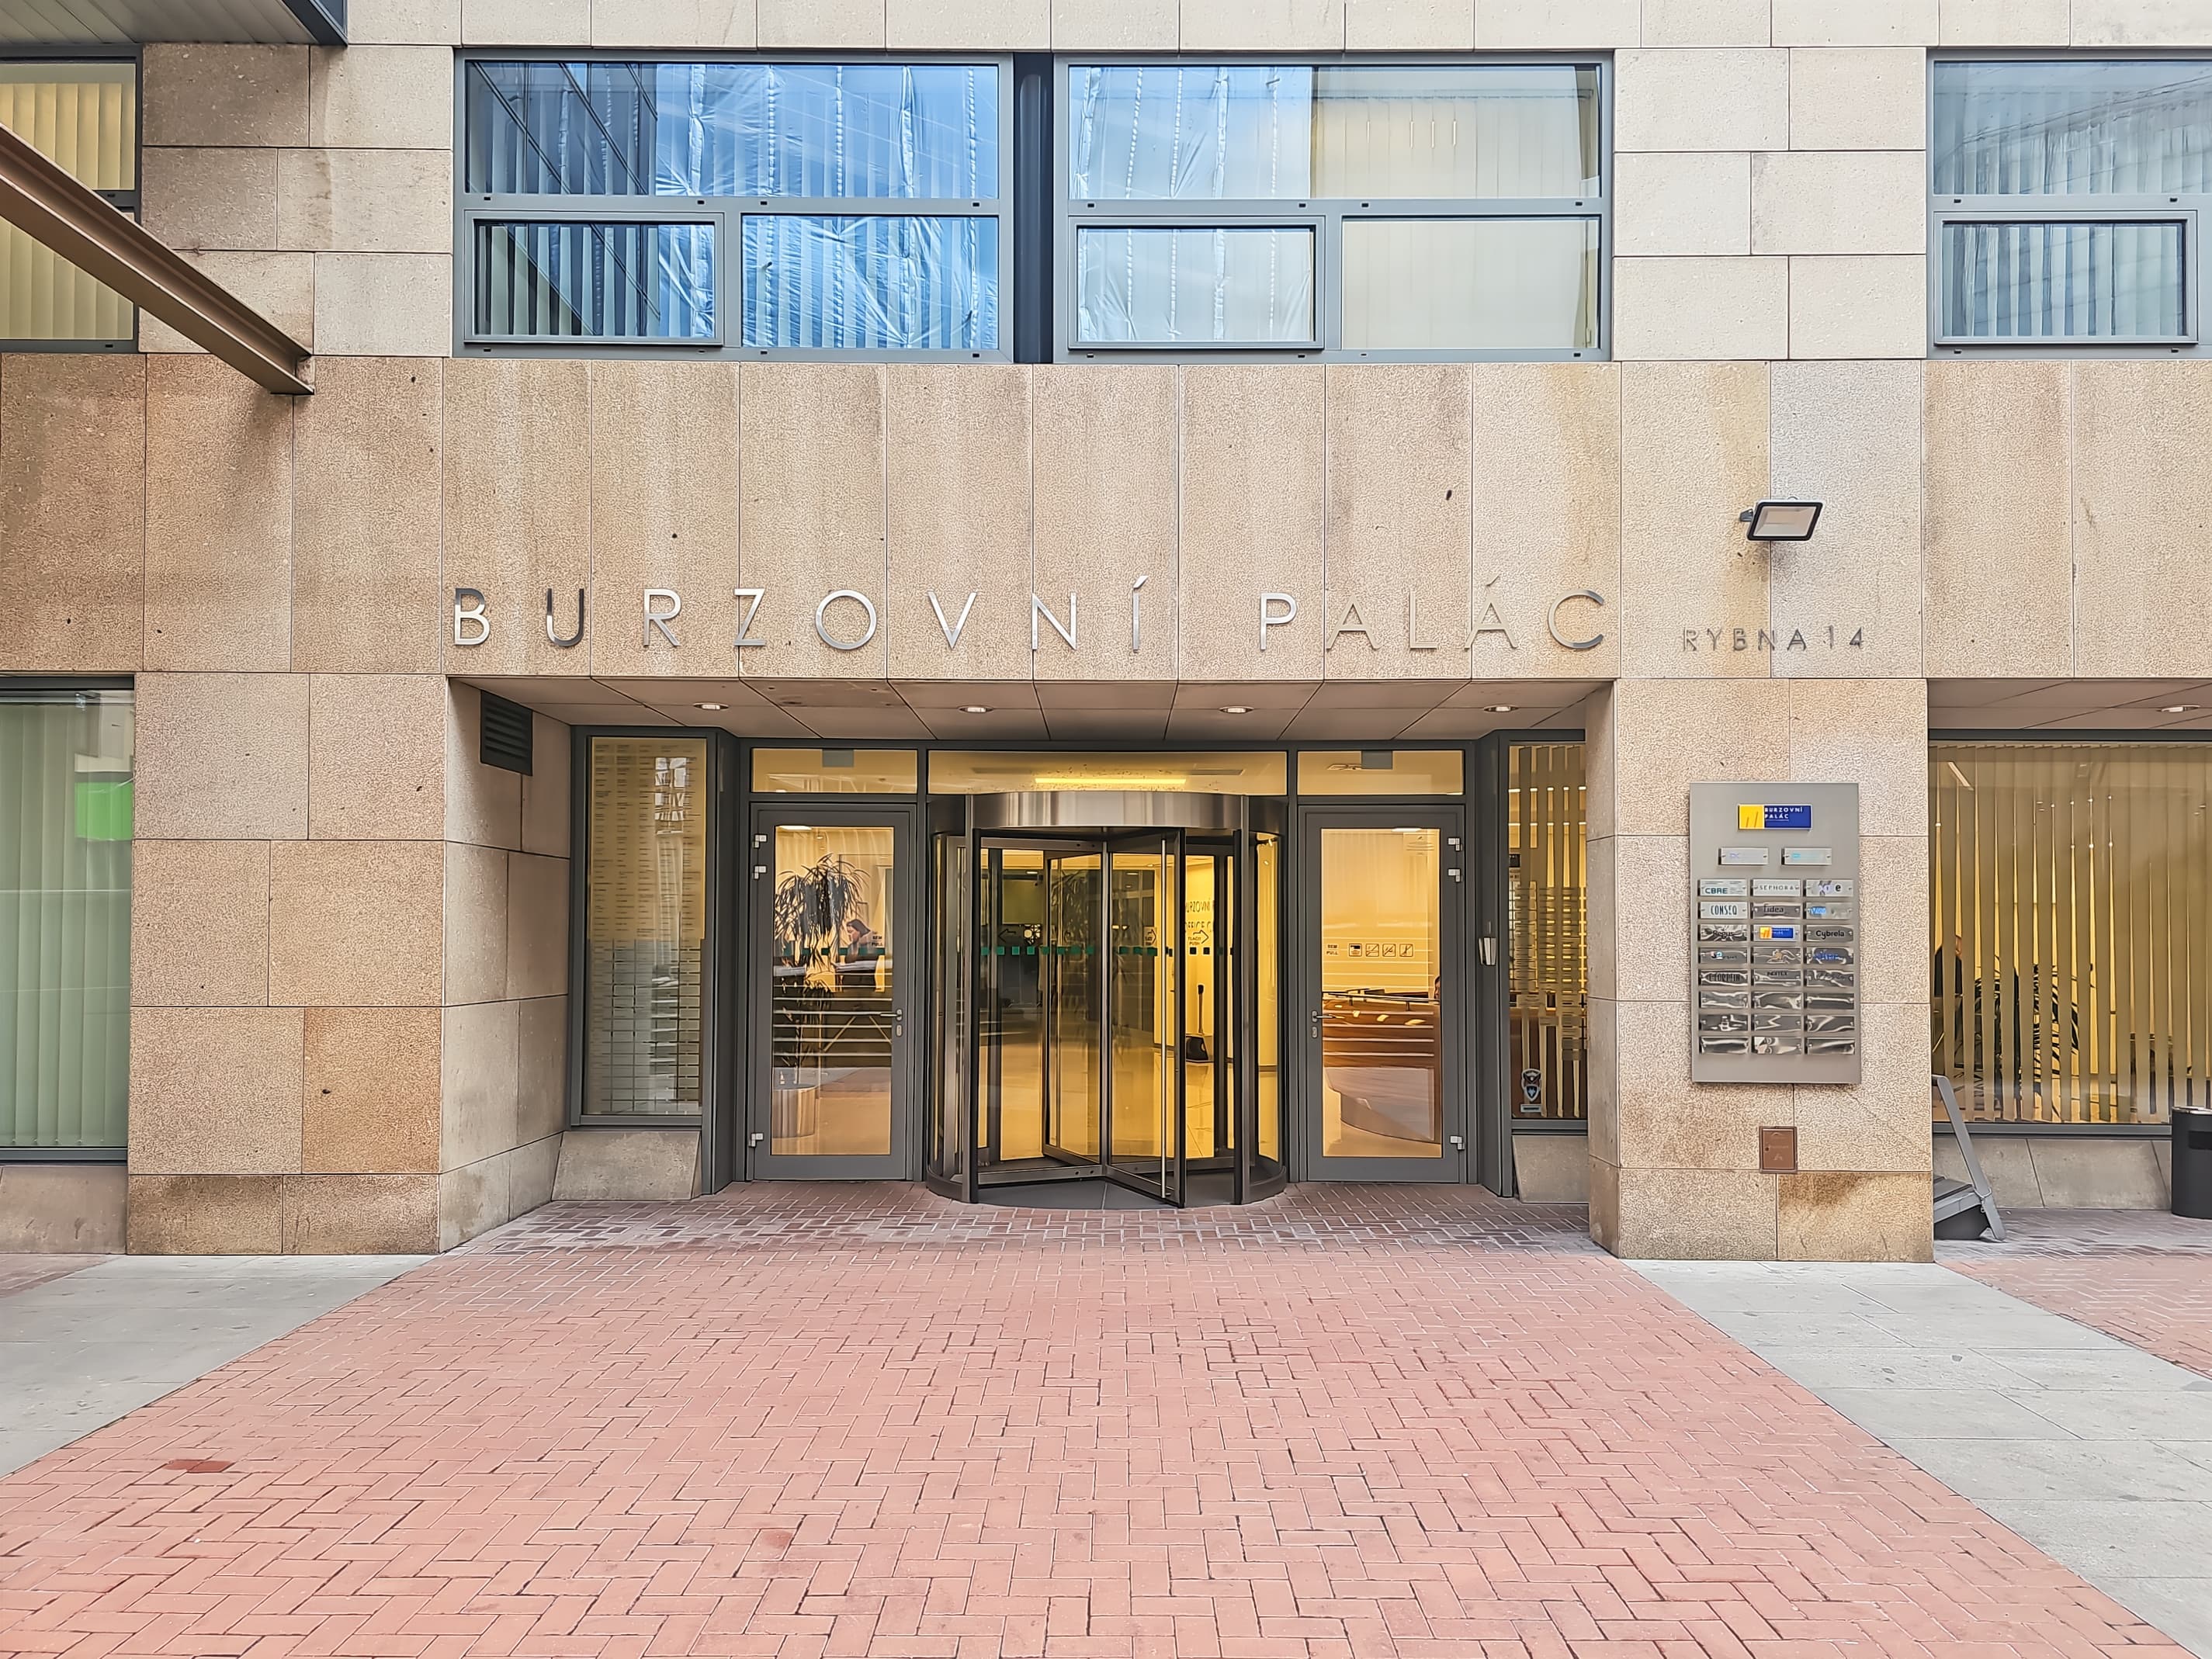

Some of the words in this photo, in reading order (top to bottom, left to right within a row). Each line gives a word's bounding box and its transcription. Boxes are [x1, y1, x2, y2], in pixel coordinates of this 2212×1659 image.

[453, 575, 1149, 651] BURZOVNÍ
[1259, 575, 1606, 650] PALÁC
[1823, 625, 1864, 649] 14
[1710, 905, 1738, 916] CONSEQ
